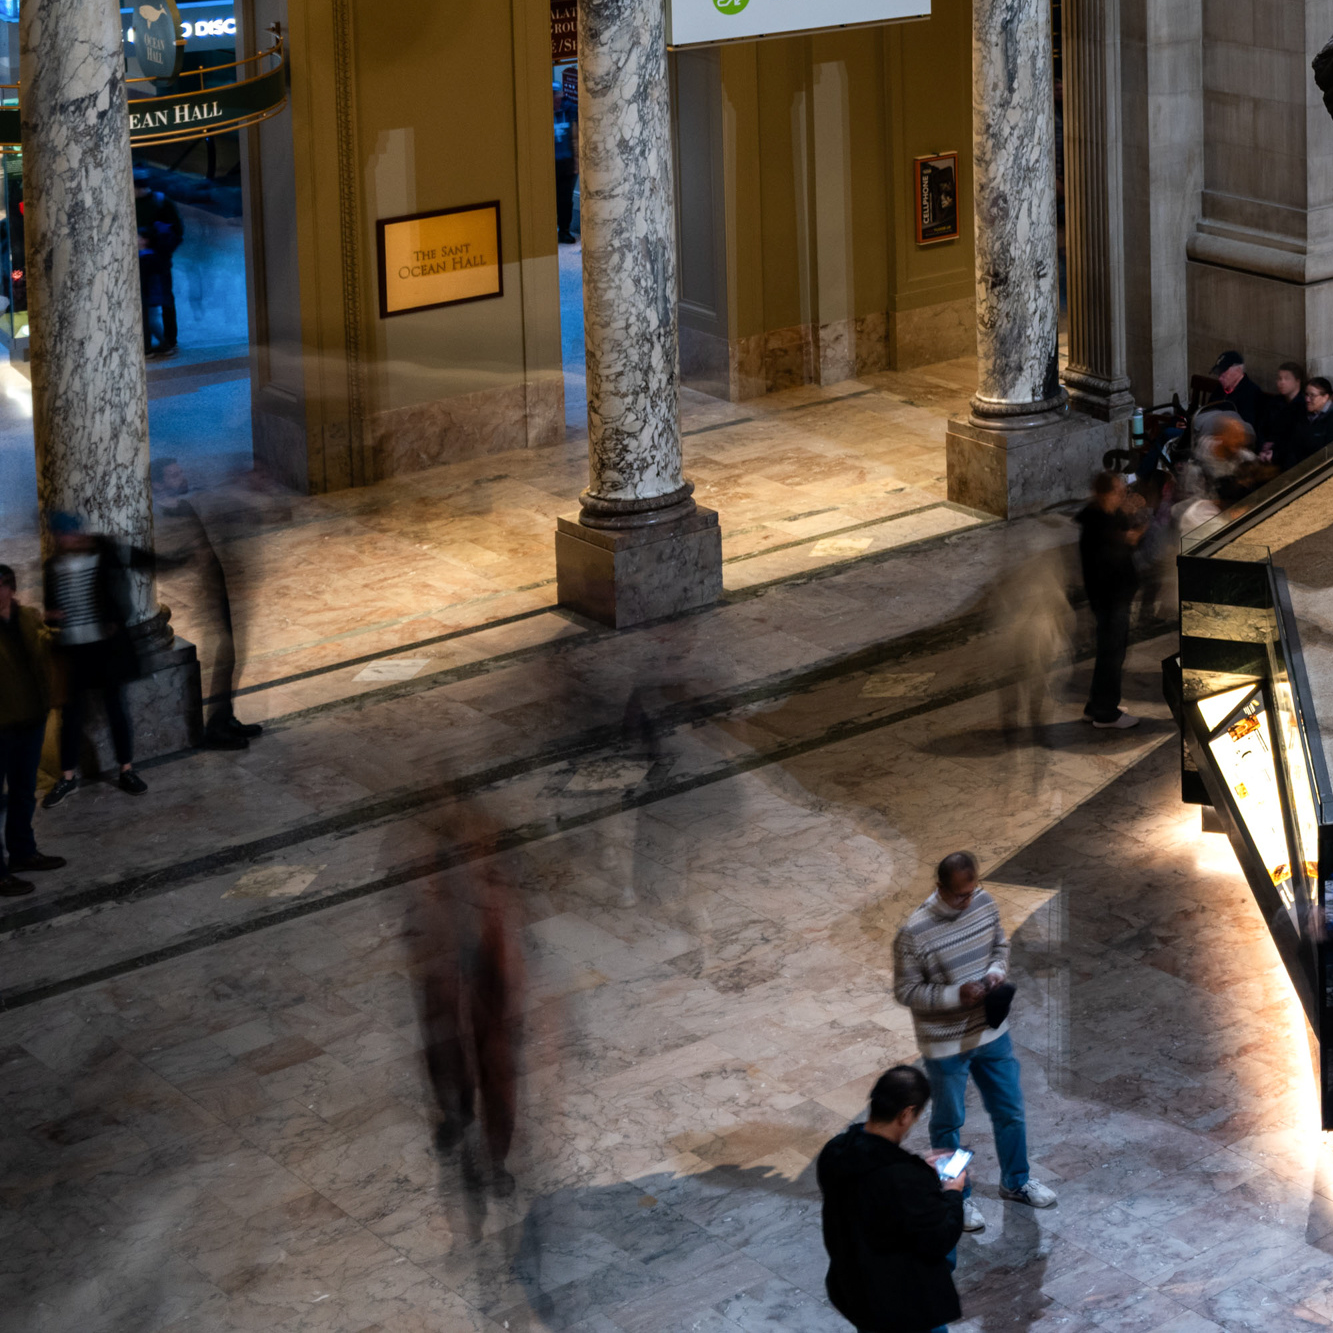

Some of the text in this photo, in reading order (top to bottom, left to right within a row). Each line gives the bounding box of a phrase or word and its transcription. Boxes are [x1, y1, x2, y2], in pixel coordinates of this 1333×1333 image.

[147, 47, 163, 64] HALL
[173, 101, 223, 125] HALL
[413, 243, 471, 262] THE SANT
[398, 255, 487, 279] OCEAN HALL
